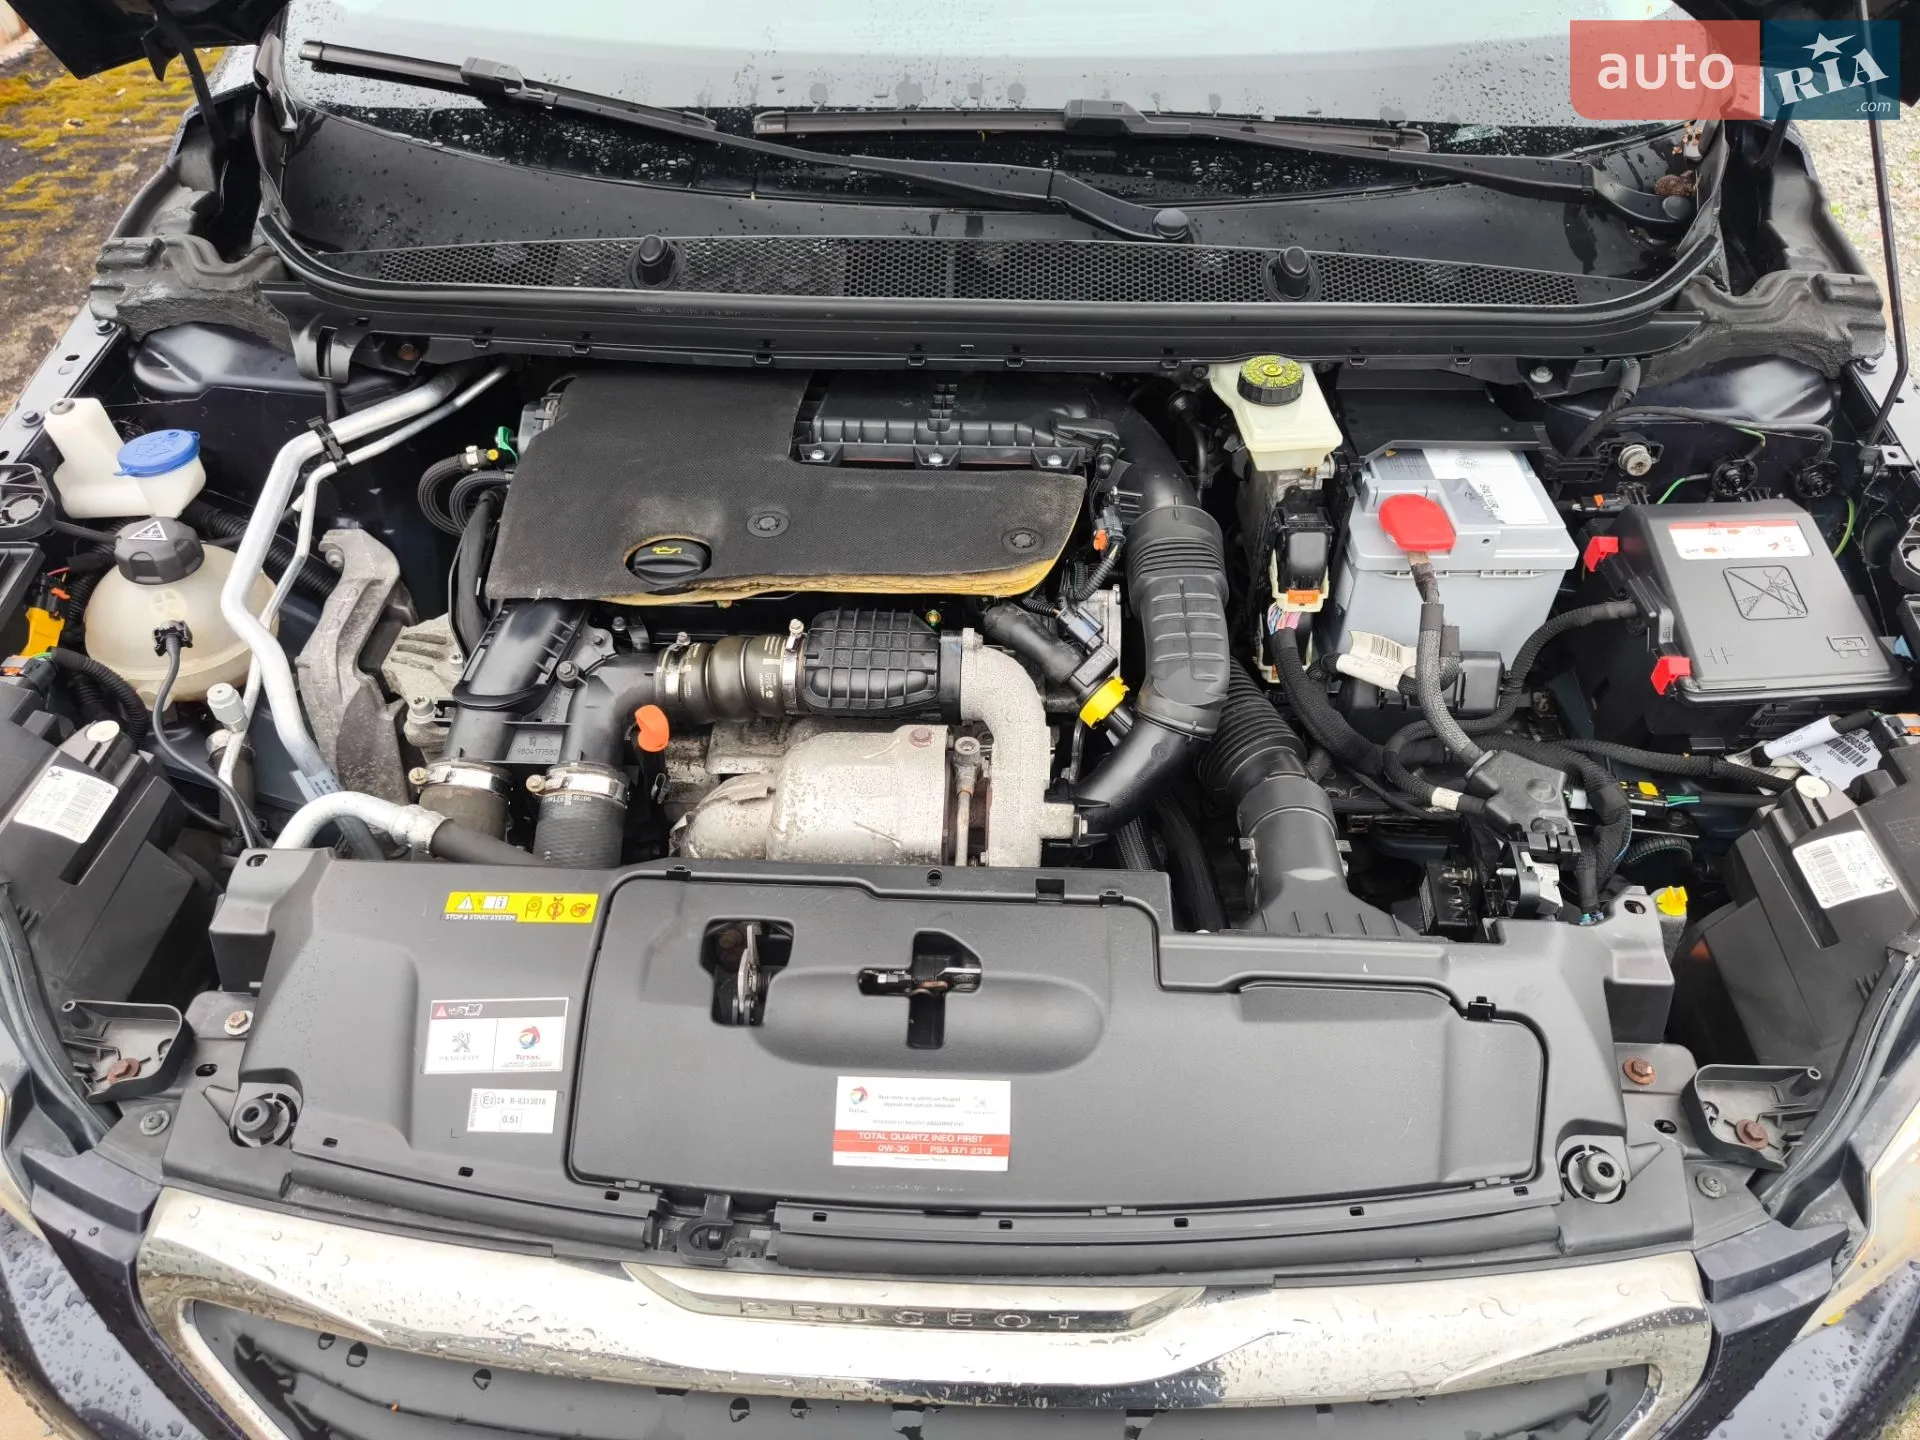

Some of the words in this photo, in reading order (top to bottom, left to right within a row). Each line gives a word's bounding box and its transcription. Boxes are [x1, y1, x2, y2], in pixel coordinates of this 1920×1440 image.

[444, 913, 462, 921] STOP
[857, 1131, 888, 1141] TOTAL
[890, 1132, 930, 1142] QUARTZ
[931, 1134, 955, 1142] INEO
[957, 1135, 984, 1144] FIRST
[929, 1145, 949, 1154] PSA
[970, 1146, 993, 1155] 2312
[739, 1300, 1080, 1330] PEUGEOT
